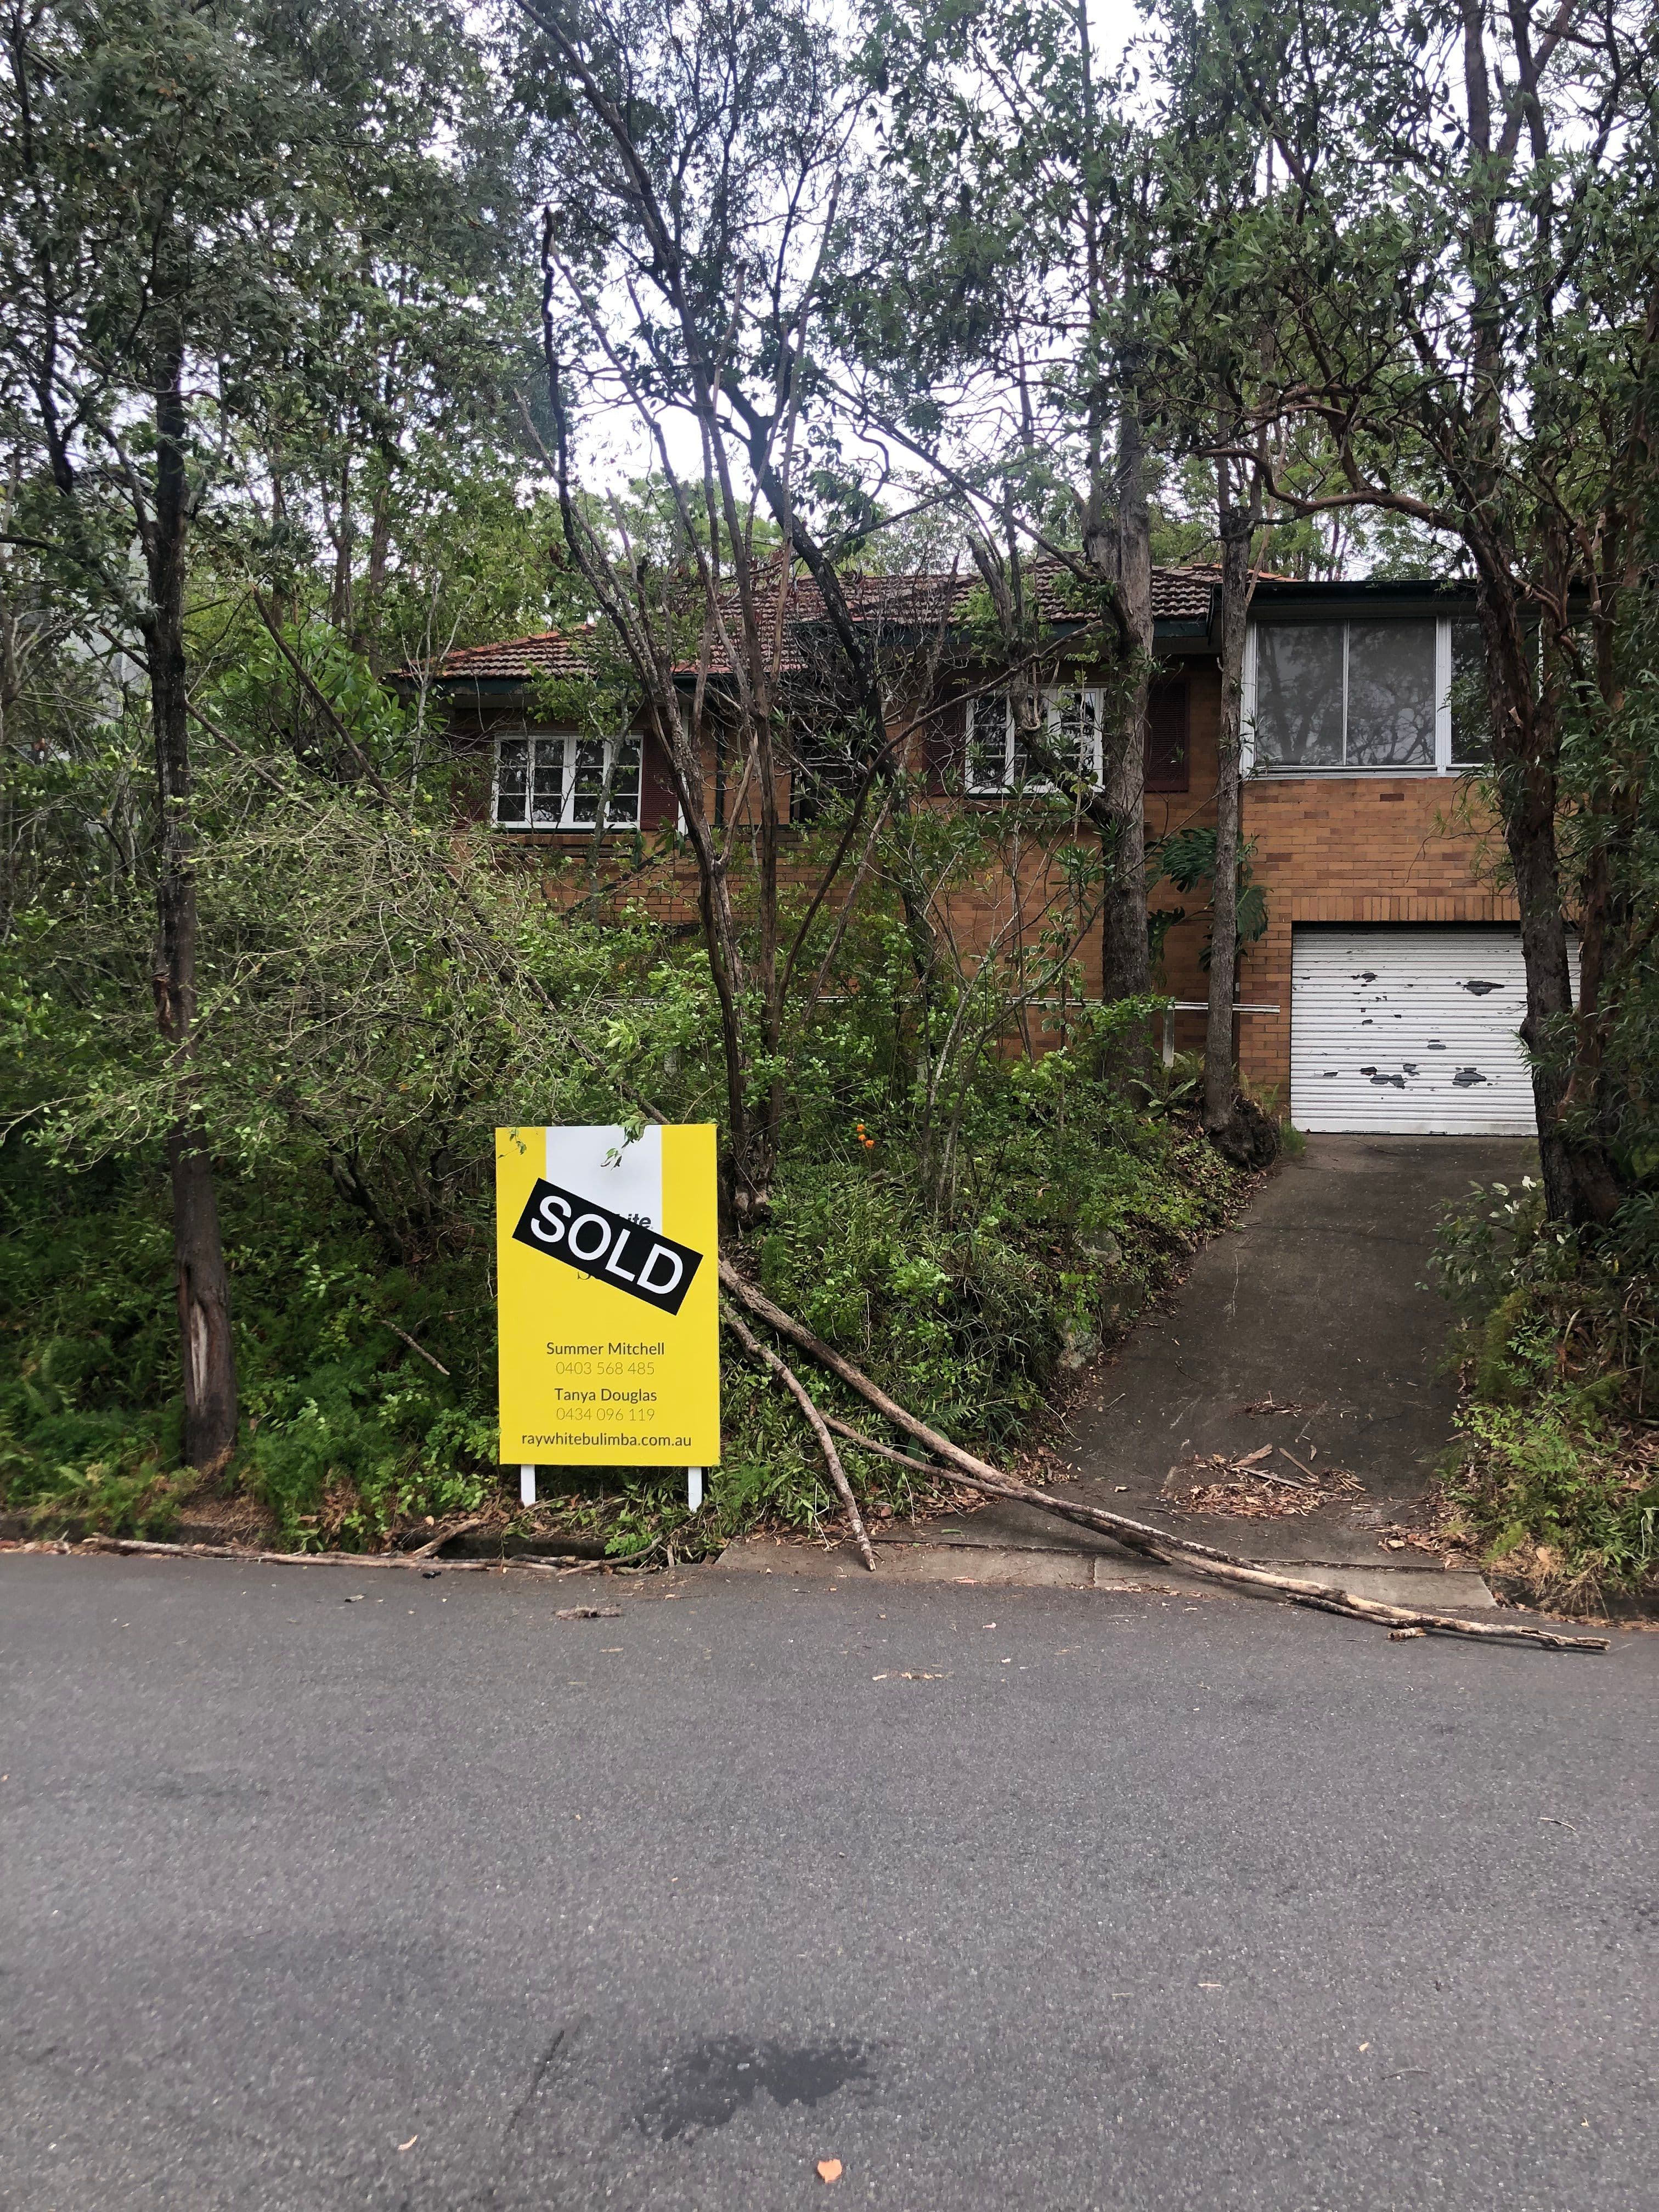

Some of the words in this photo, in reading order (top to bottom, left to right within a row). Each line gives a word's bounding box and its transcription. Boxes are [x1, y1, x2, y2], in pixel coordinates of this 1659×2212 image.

[531, 1195, 684, 1294] SOLD
[546, 1342, 603, 1356] Summer
[608, 1342, 664, 1355] Mitchell
[556, 1361, 592, 1375] 0403
[597, 1362, 623, 1375] 568
[627, 1362, 654, 1375] 485
[554, 1388, 596, 1403] Tanya
[601, 1389, 657, 1404] Douglas
[556, 1408, 592, 1421] 0434
[596, 1408, 623, 1421] 096
[629, 1408, 655, 1421] 119
[522, 1432, 692, 1447] raywhitebulimba.com.au
